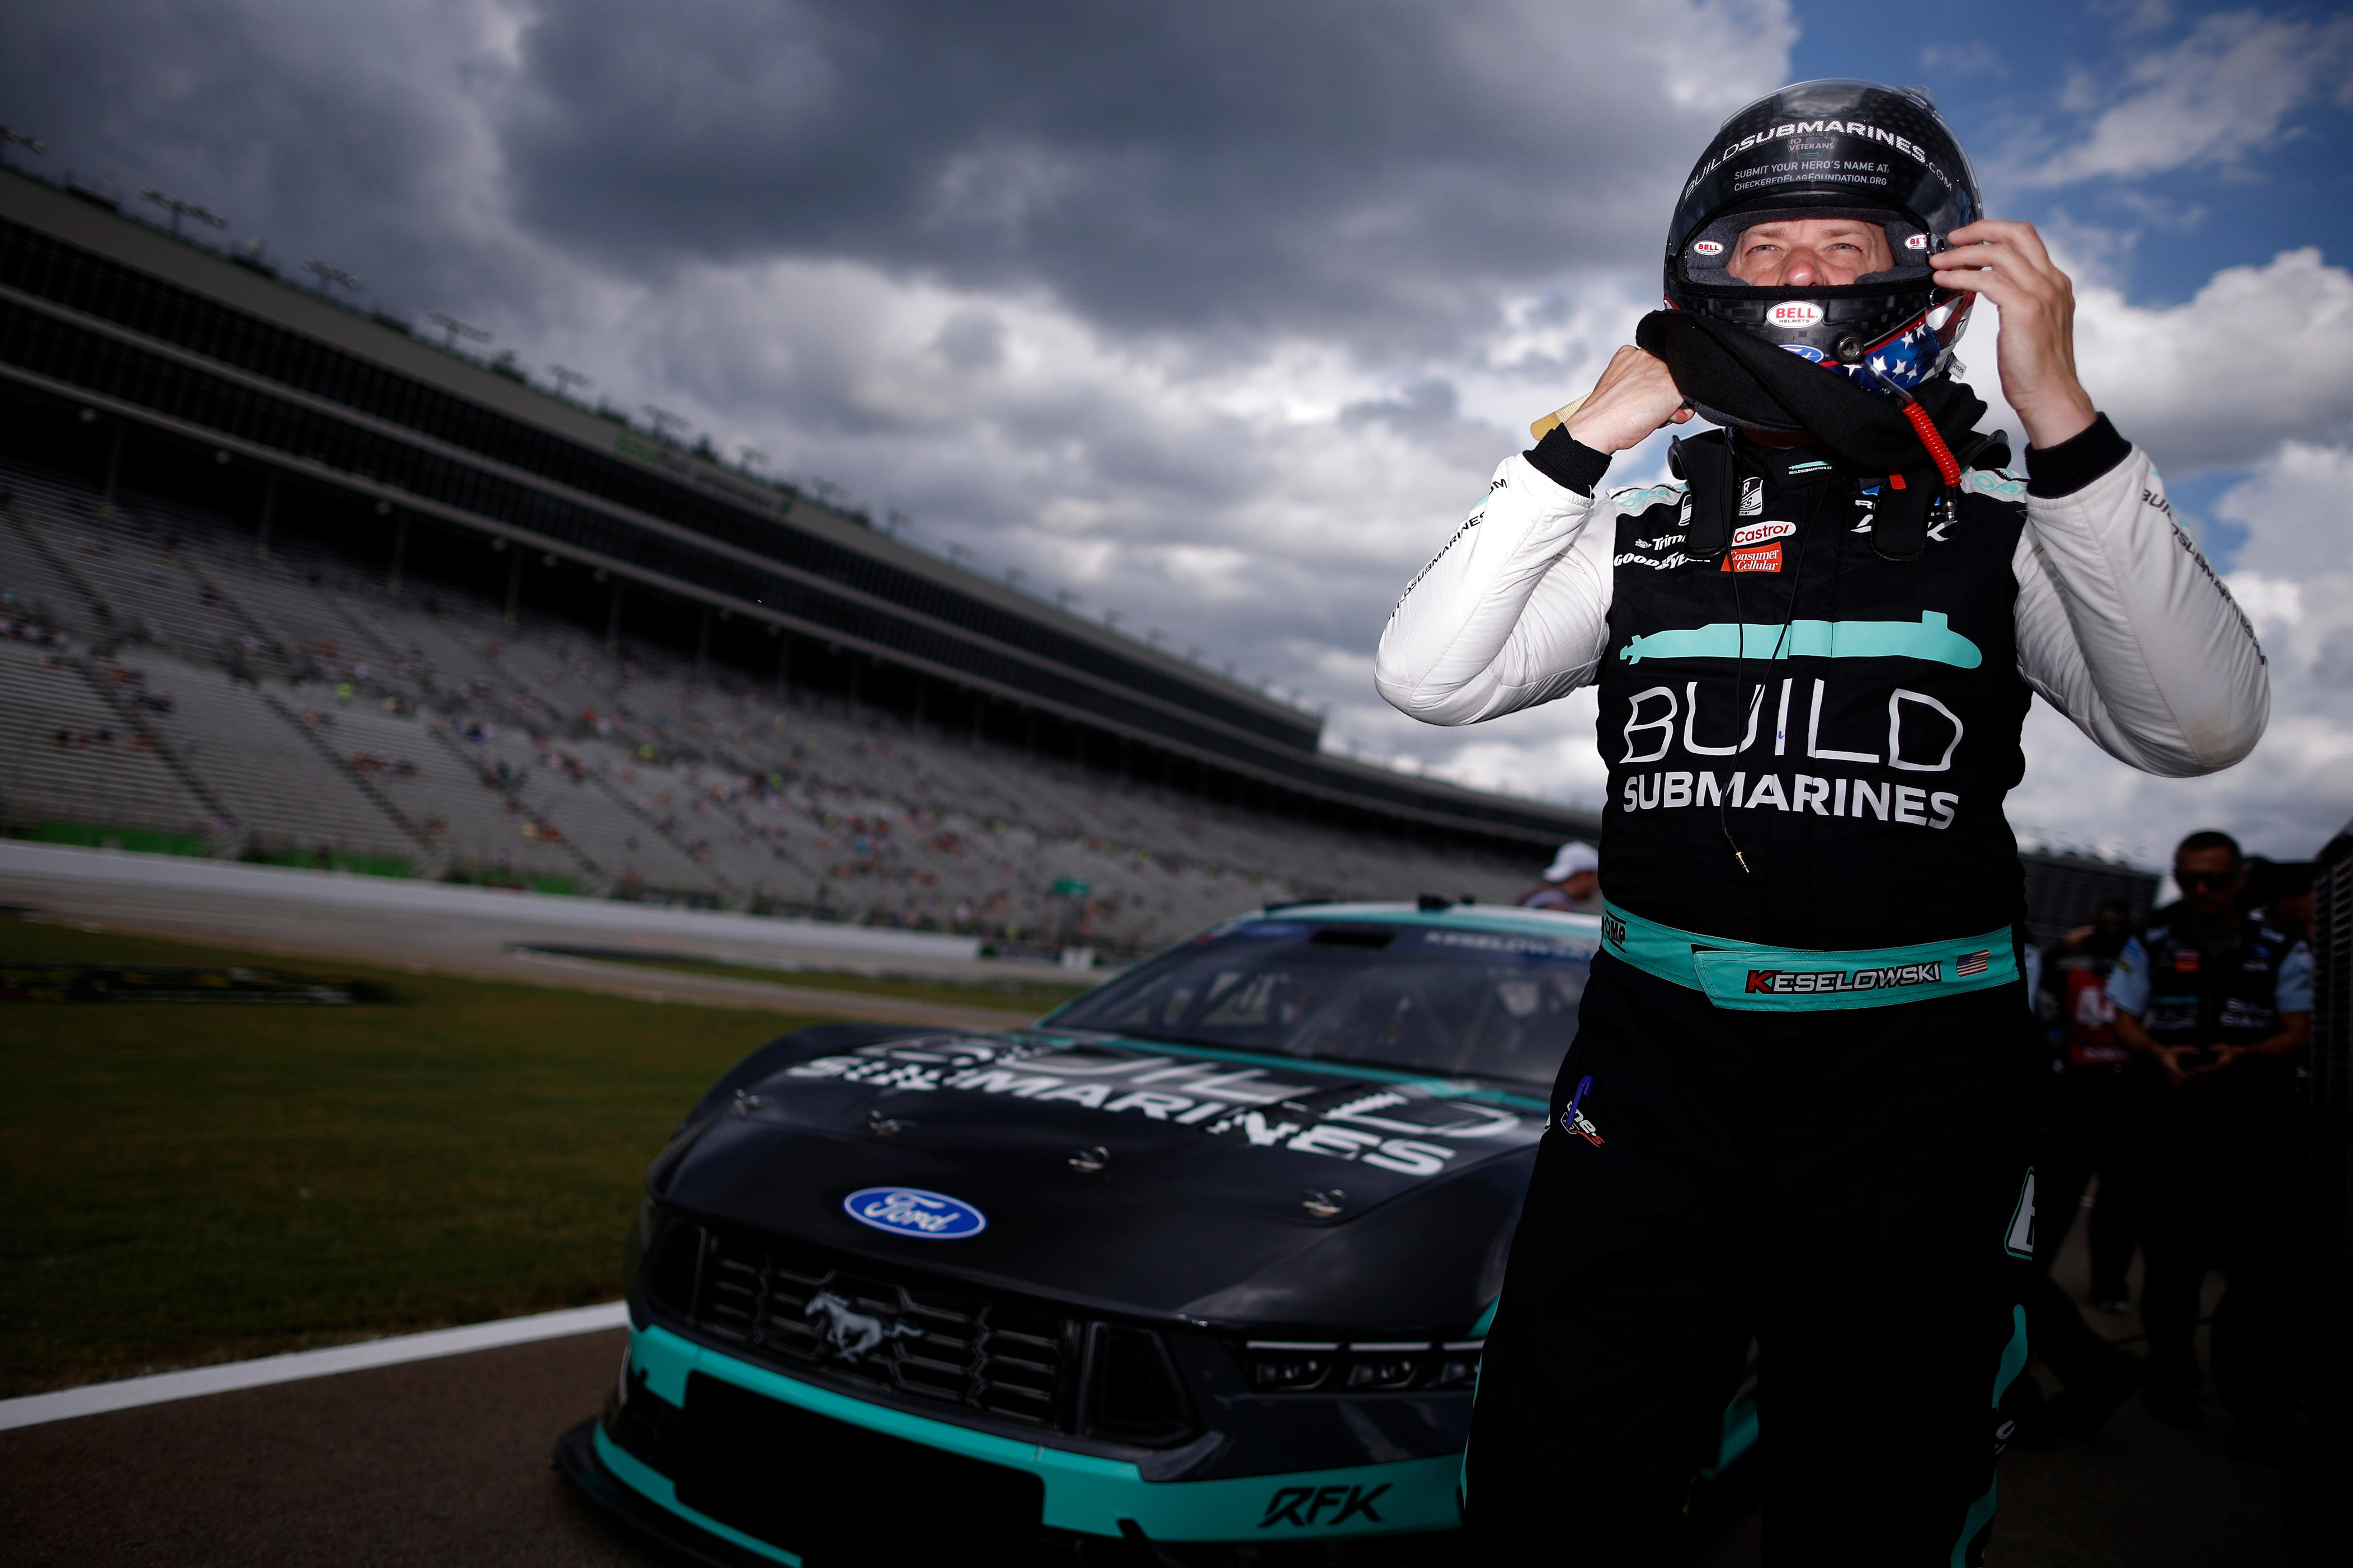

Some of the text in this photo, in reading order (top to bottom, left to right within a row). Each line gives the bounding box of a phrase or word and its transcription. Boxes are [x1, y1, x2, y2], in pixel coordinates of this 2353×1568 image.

[1789, 142, 1834, 151] VETERANS
[1734, 160, 1890, 180] SUBMIT YOUR HERO'S NAME AT:
[1775, 308, 1816, 319] BELL
[1652, 534, 1686, 551] Trim
[1734, 524, 1789, 544] Castrol
[1730, 549, 1779, 561] Consumer
[1737, 560, 1779, 570] Cellular
[1619, 678, 1964, 772] BUILD
[1623, 772, 1959, 829] SUBMARINES
[1746, 961, 1941, 994] KESELOWSKI
[864, 1192, 961, 1232] Ford
[1257, 1483, 1394, 1529] RFK
